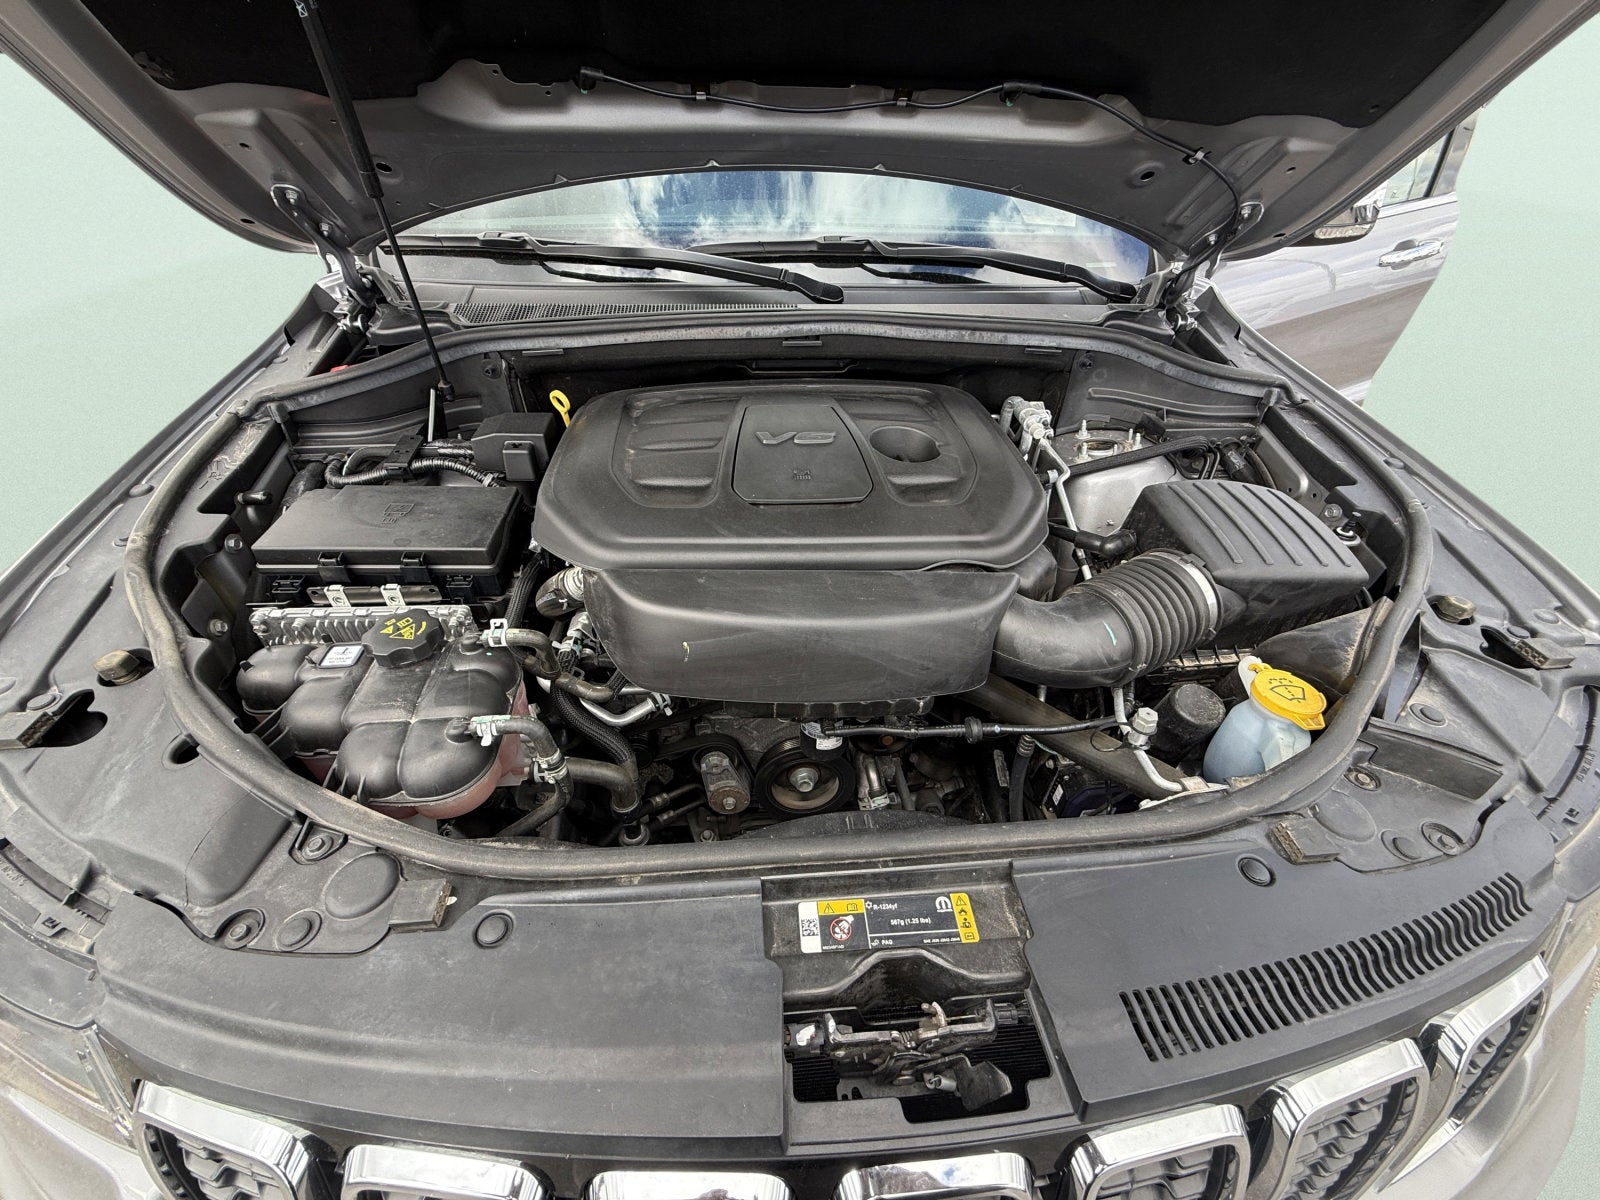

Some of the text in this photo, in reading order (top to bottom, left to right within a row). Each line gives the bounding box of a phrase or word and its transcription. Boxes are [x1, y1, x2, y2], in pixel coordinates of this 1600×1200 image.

[755, 431, 836, 445] V6
[873, 903, 898, 911] R-1234yf
[890, 918, 904, 926] 567g
[905, 918, 919, 926] (1.25
